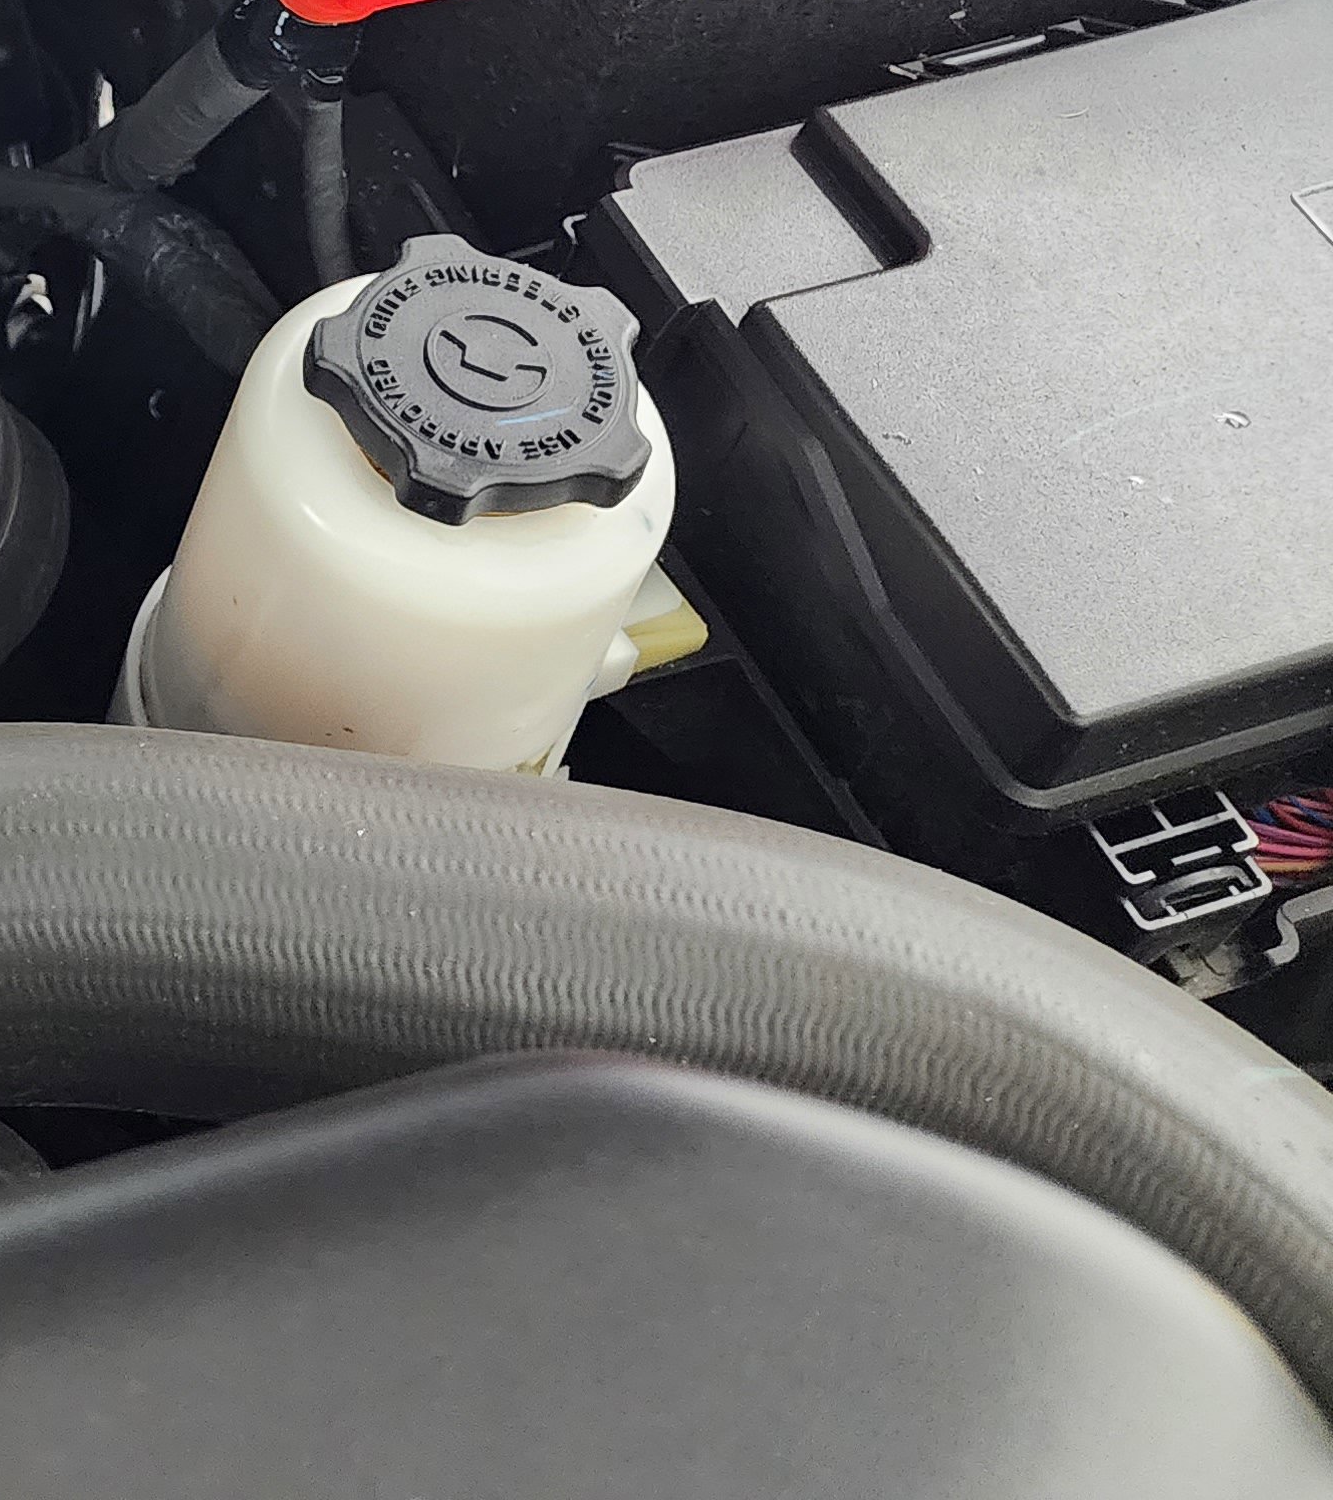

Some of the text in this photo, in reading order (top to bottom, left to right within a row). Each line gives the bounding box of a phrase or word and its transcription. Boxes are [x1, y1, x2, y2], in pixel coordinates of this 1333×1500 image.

[364, 264, 617, 426] POWER STEERING FLUID
[366, 357, 584, 461] USE APPROVED
